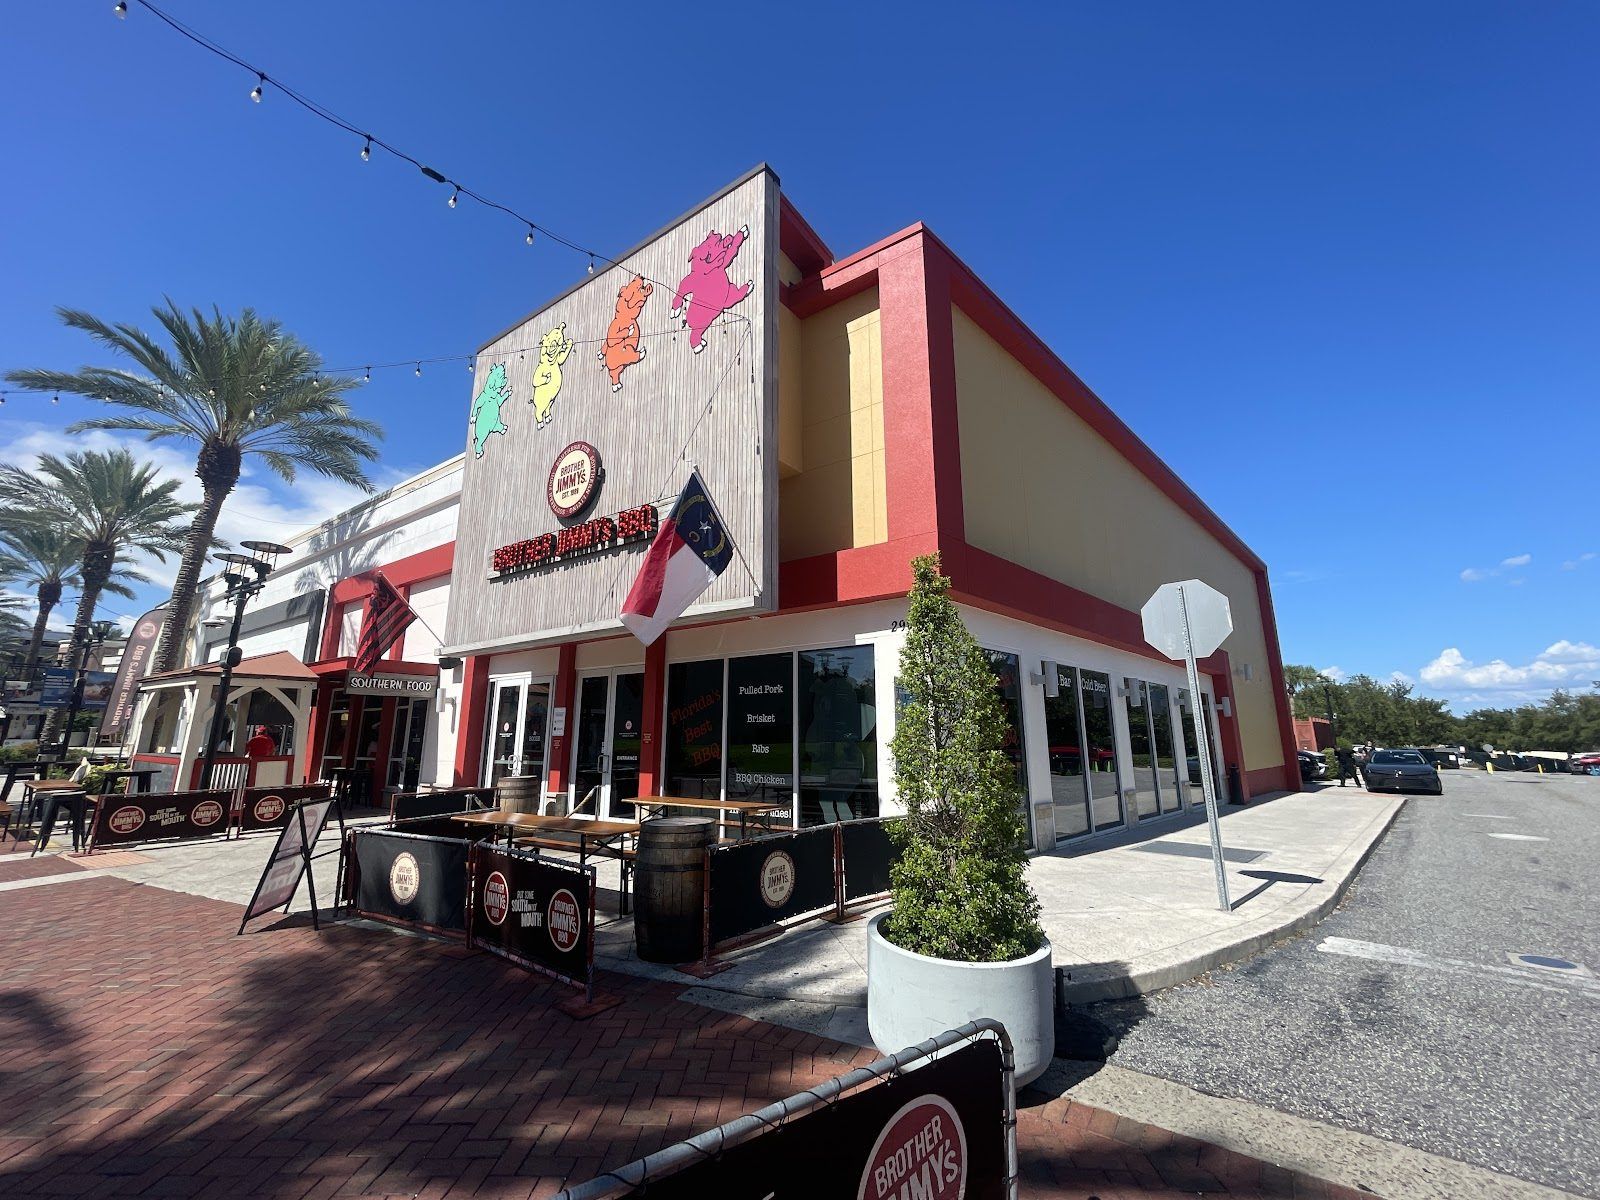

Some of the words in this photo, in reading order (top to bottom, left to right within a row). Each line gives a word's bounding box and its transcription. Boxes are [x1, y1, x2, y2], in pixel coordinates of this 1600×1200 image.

[560, 459, 585, 477] BROTHER
[555, 469, 586, 494] JIMMY'S
[111, 691, 129, 726] BROTHER
[124, 661, 139, 691] JIMMY'S
[132, 644, 146, 661] BBQ
[350, 677, 403, 690] SOUTHERN
[406, 681, 432, 691] FOOD
[1059, 674, 1072, 688] Bar
[1095, 680, 1107, 693] Beer
[739, 686, 763, 695] Pulled
[764, 684, 784, 694] Pork
[746, 714, 776, 723] Brisket
[684, 719, 713, 744] Best
[752, 744, 770, 754] Ribs
[735, 773, 752, 784] BBQ
[753, 774, 786, 785] Chicken
[486, 890, 507, 910] JIMMY'S
[511, 899, 529, 913] SOUTH
[554, 899, 575, 916] BROTHER
[551, 910, 577, 934] JIMMY'S
[557, 930, 569, 944] BBQ
[874, 1114, 944, 1199] BROTHER
